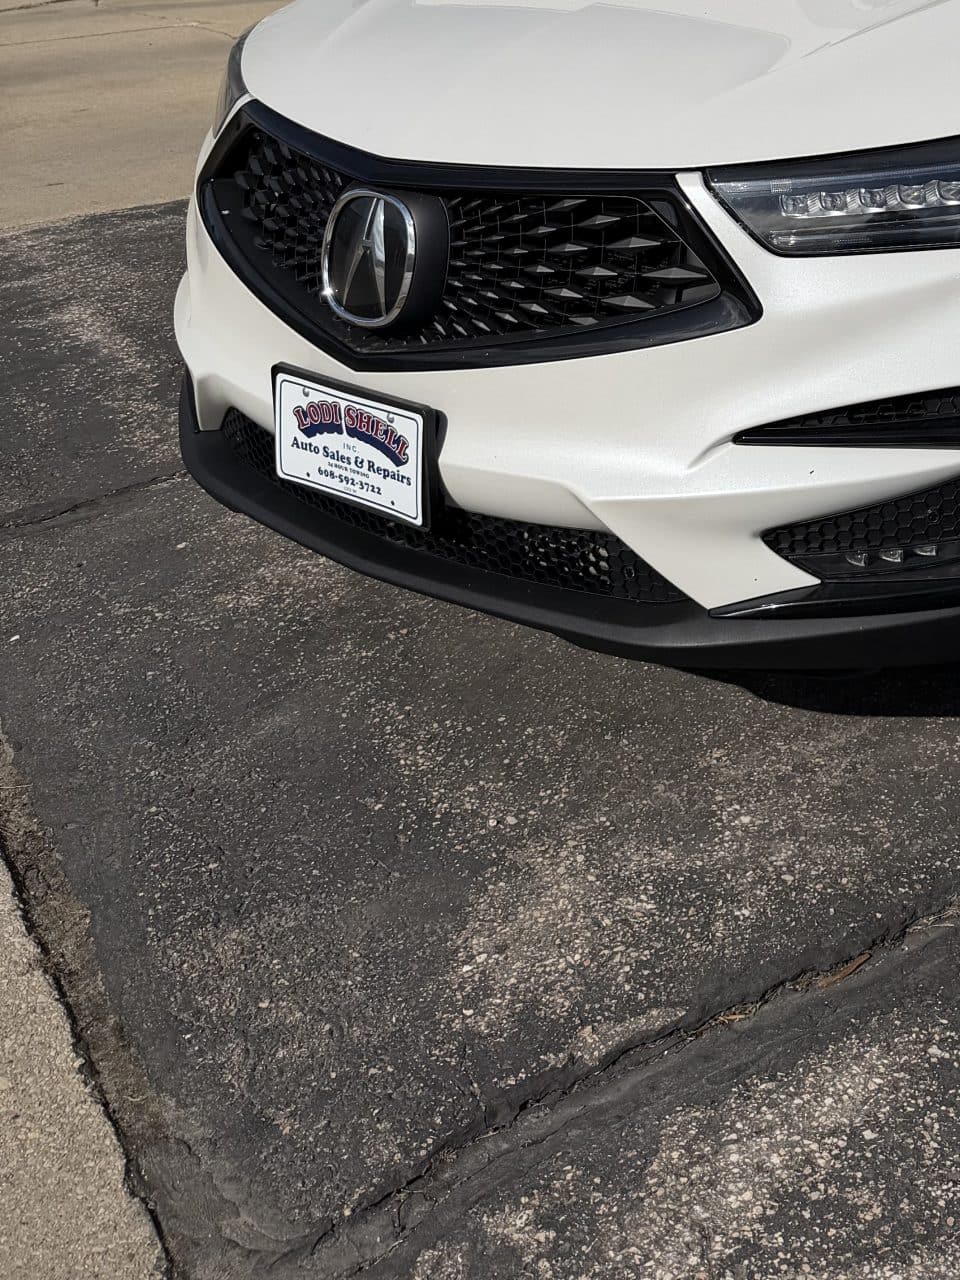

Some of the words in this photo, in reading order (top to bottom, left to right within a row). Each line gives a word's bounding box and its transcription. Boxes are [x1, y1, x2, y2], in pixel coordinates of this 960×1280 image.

[294, 401, 342, 434] LODI
[344, 405, 409, 464] SHELL
[291, 436, 320, 455] Auto
[322, 445, 352, 466] Sales
[354, 456, 365, 469] &
[367, 459, 412, 486] Repairs
